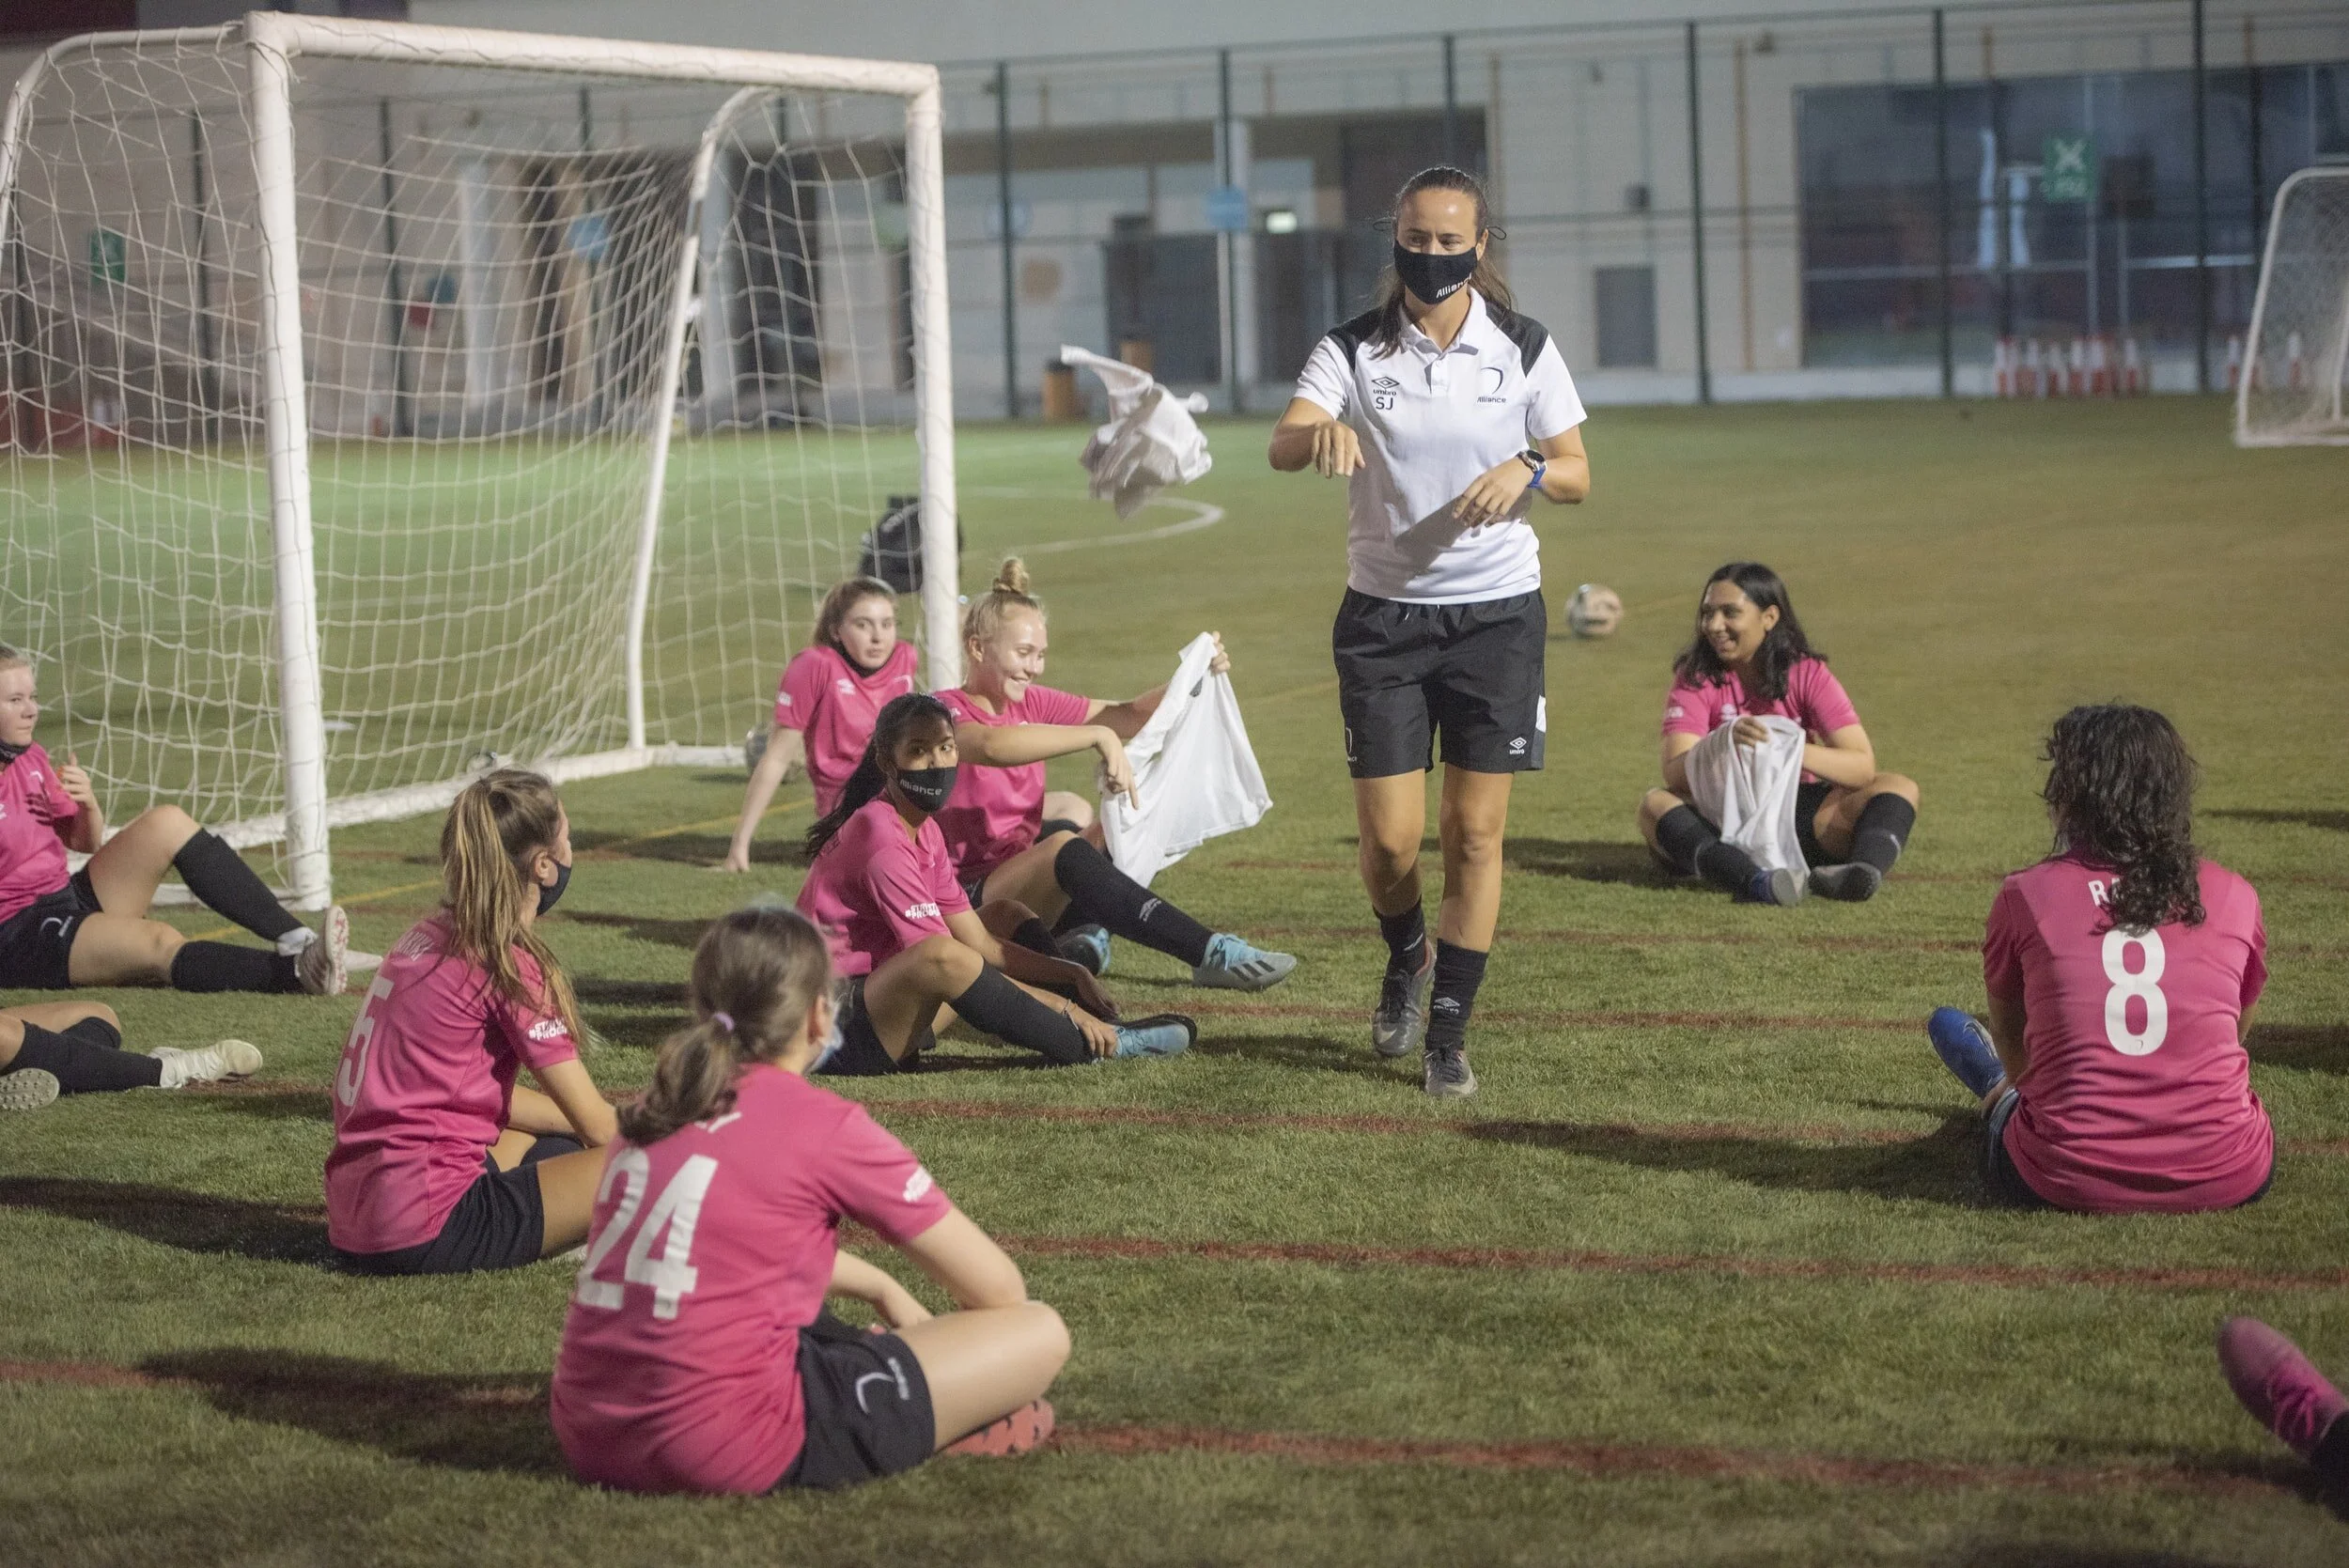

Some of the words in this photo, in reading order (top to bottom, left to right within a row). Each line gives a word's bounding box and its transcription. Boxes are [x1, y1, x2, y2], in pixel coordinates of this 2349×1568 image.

[1376, 396, 1393, 411] SJ
[1477, 396, 1506, 404] Alliance
[2102, 925, 2168, 1056] 8
[576, 1147, 719, 1320] 24
